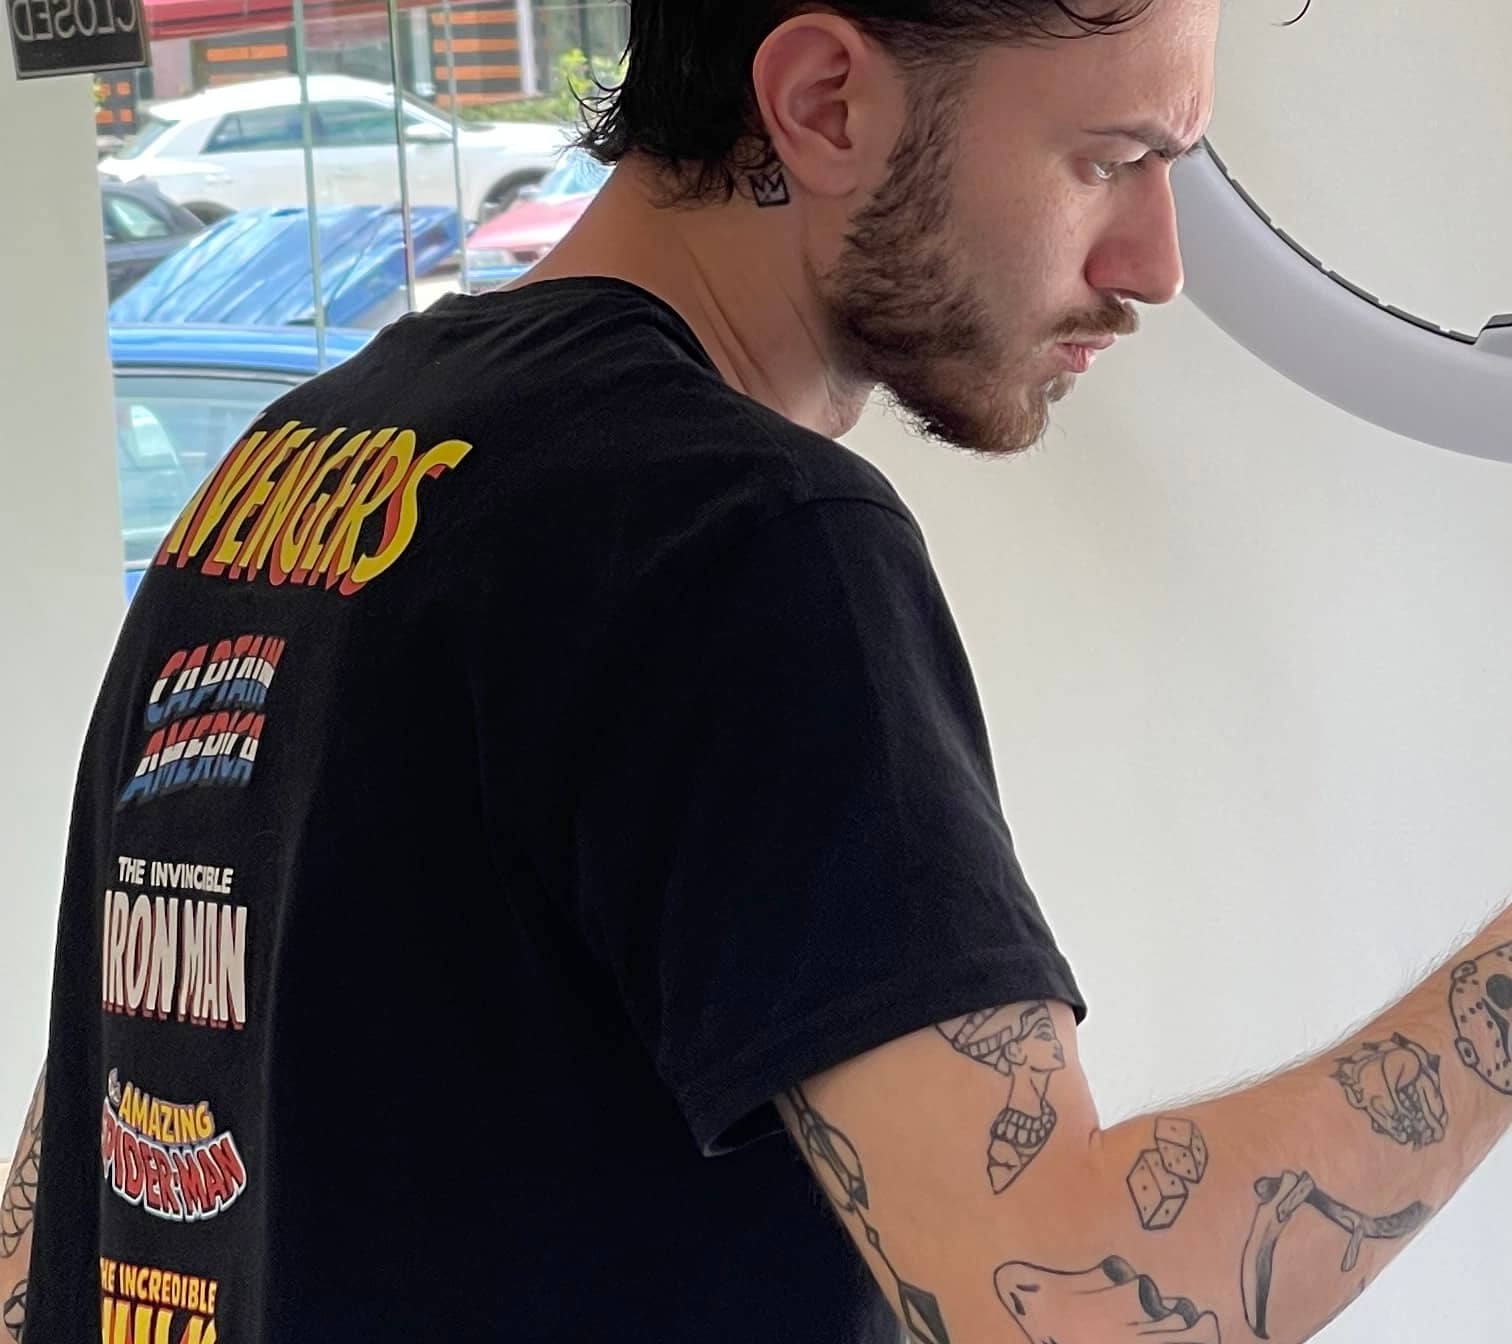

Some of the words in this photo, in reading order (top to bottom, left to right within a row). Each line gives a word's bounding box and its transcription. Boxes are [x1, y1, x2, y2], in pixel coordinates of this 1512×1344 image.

[146, 634, 286, 724] CAPTAIN
[119, 711, 266, 803] AMERICA
[118, 856, 146, 885] THE
[150, 861, 234, 895] INVINCIBLE
[102, 890, 178, 1020] IRON
[178, 899, 248, 1030] MAN
[118, 1082, 216, 1145] AMAZING
[101, 1097, 248, 1224] PIDER-MAN
[100, 1257, 116, 1293] HE
[119, 1263, 219, 1313] INCREDIBLE
